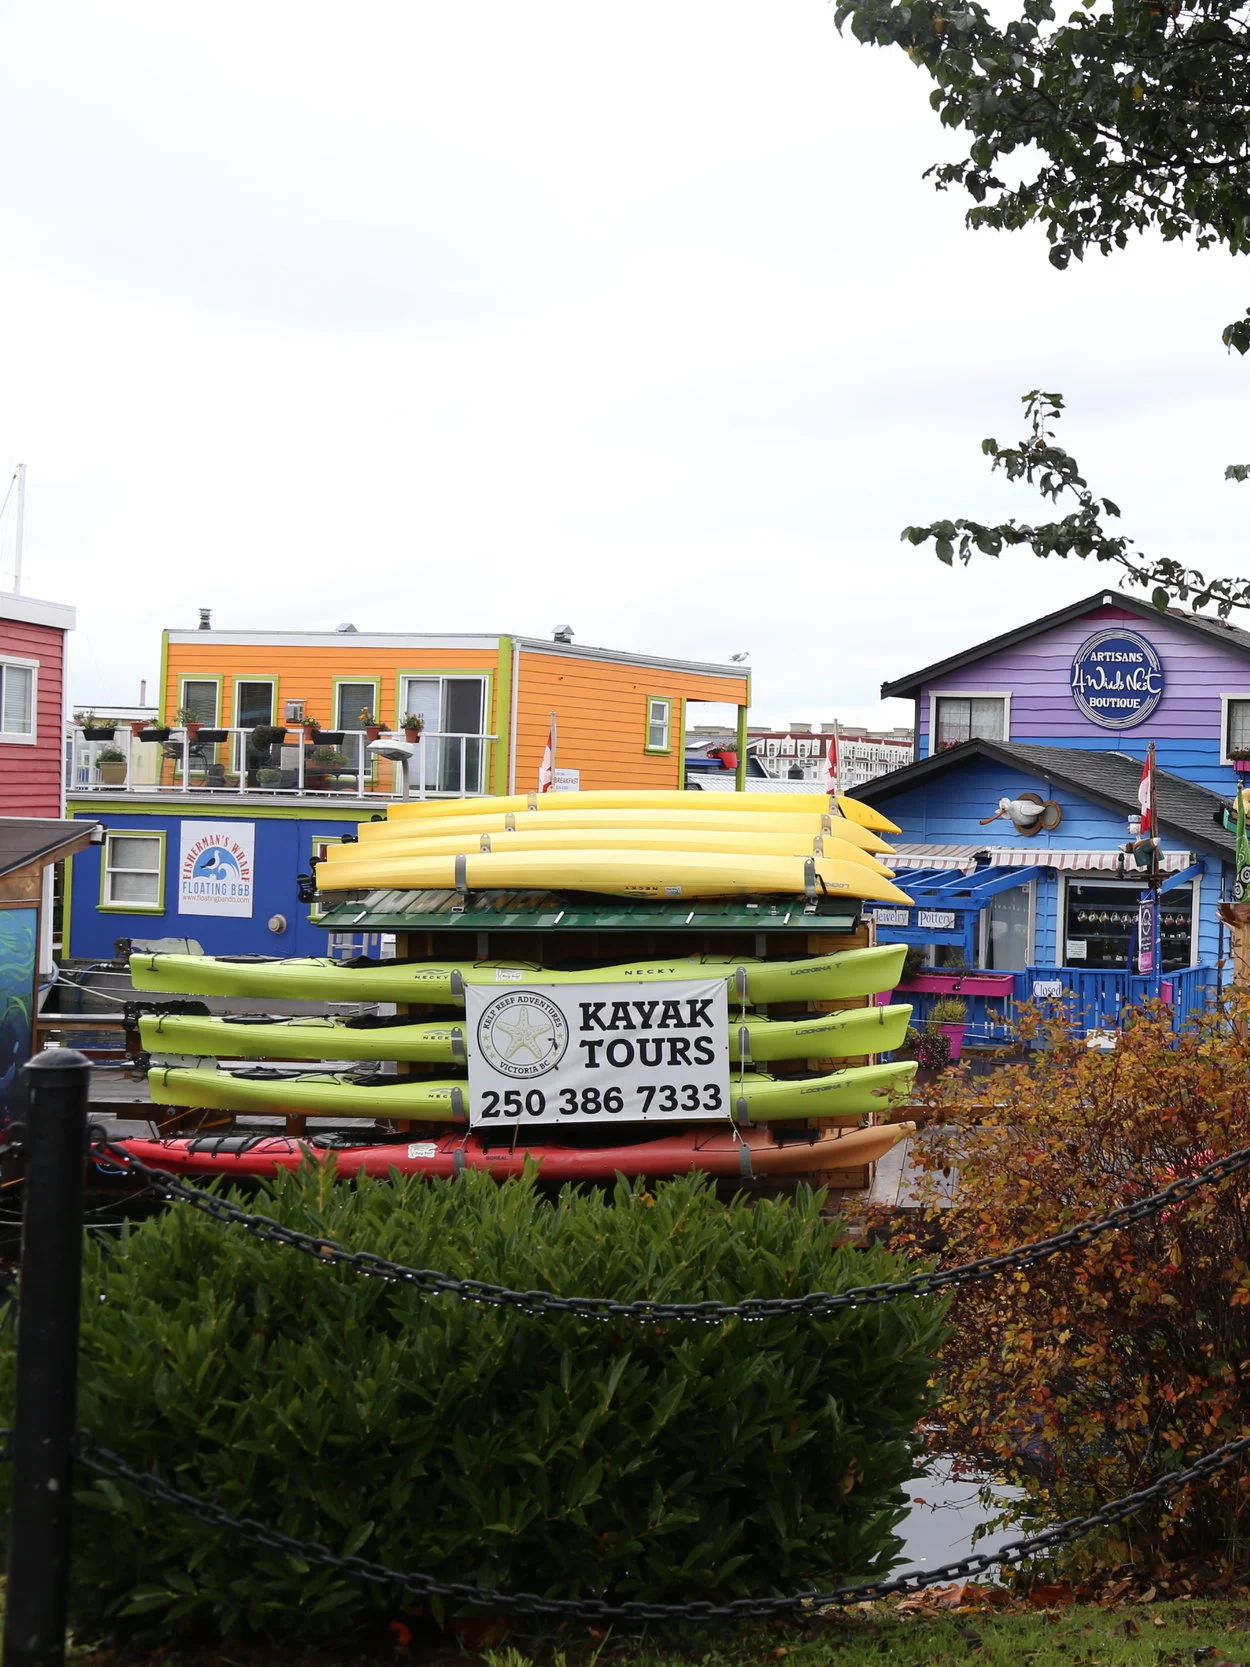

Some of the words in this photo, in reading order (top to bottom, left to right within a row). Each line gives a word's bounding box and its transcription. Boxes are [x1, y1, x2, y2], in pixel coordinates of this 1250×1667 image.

[1090, 651, 1144, 663] ARTISANS
[1072, 663, 1087, 694] 4
[1125, 667, 1163, 694] Nest
[1089, 697, 1141, 709] BOUTIQUE
[183, 834, 230, 880] FISHERMAN'S
[231, 842, 251, 883] WHARF
[182, 881, 227, 896] FLOATING
[231, 884, 250, 897] B&B
[876, 909, 907, 923] Jewelry
[920, 911, 953, 926] Pottery
[625, 968, 676, 976] NECKY
[1033, 982, 1061, 997] Closed
[483, 1009, 496, 1030] KELP
[495, 997, 515, 1011] REEF
[517, 996, 562, 1028] ADVENTURES
[579, 999, 714, 1031] KAYAK
[579, 1036, 715, 1068] TOURS
[500, 1061, 539, 1074] VICTORIA
[540, 1059, 551, 1070] BC
[481, 1089, 546, 1119] 250
[559, 1086, 624, 1115] 386
[636, 1083, 723, 1113] 7333
